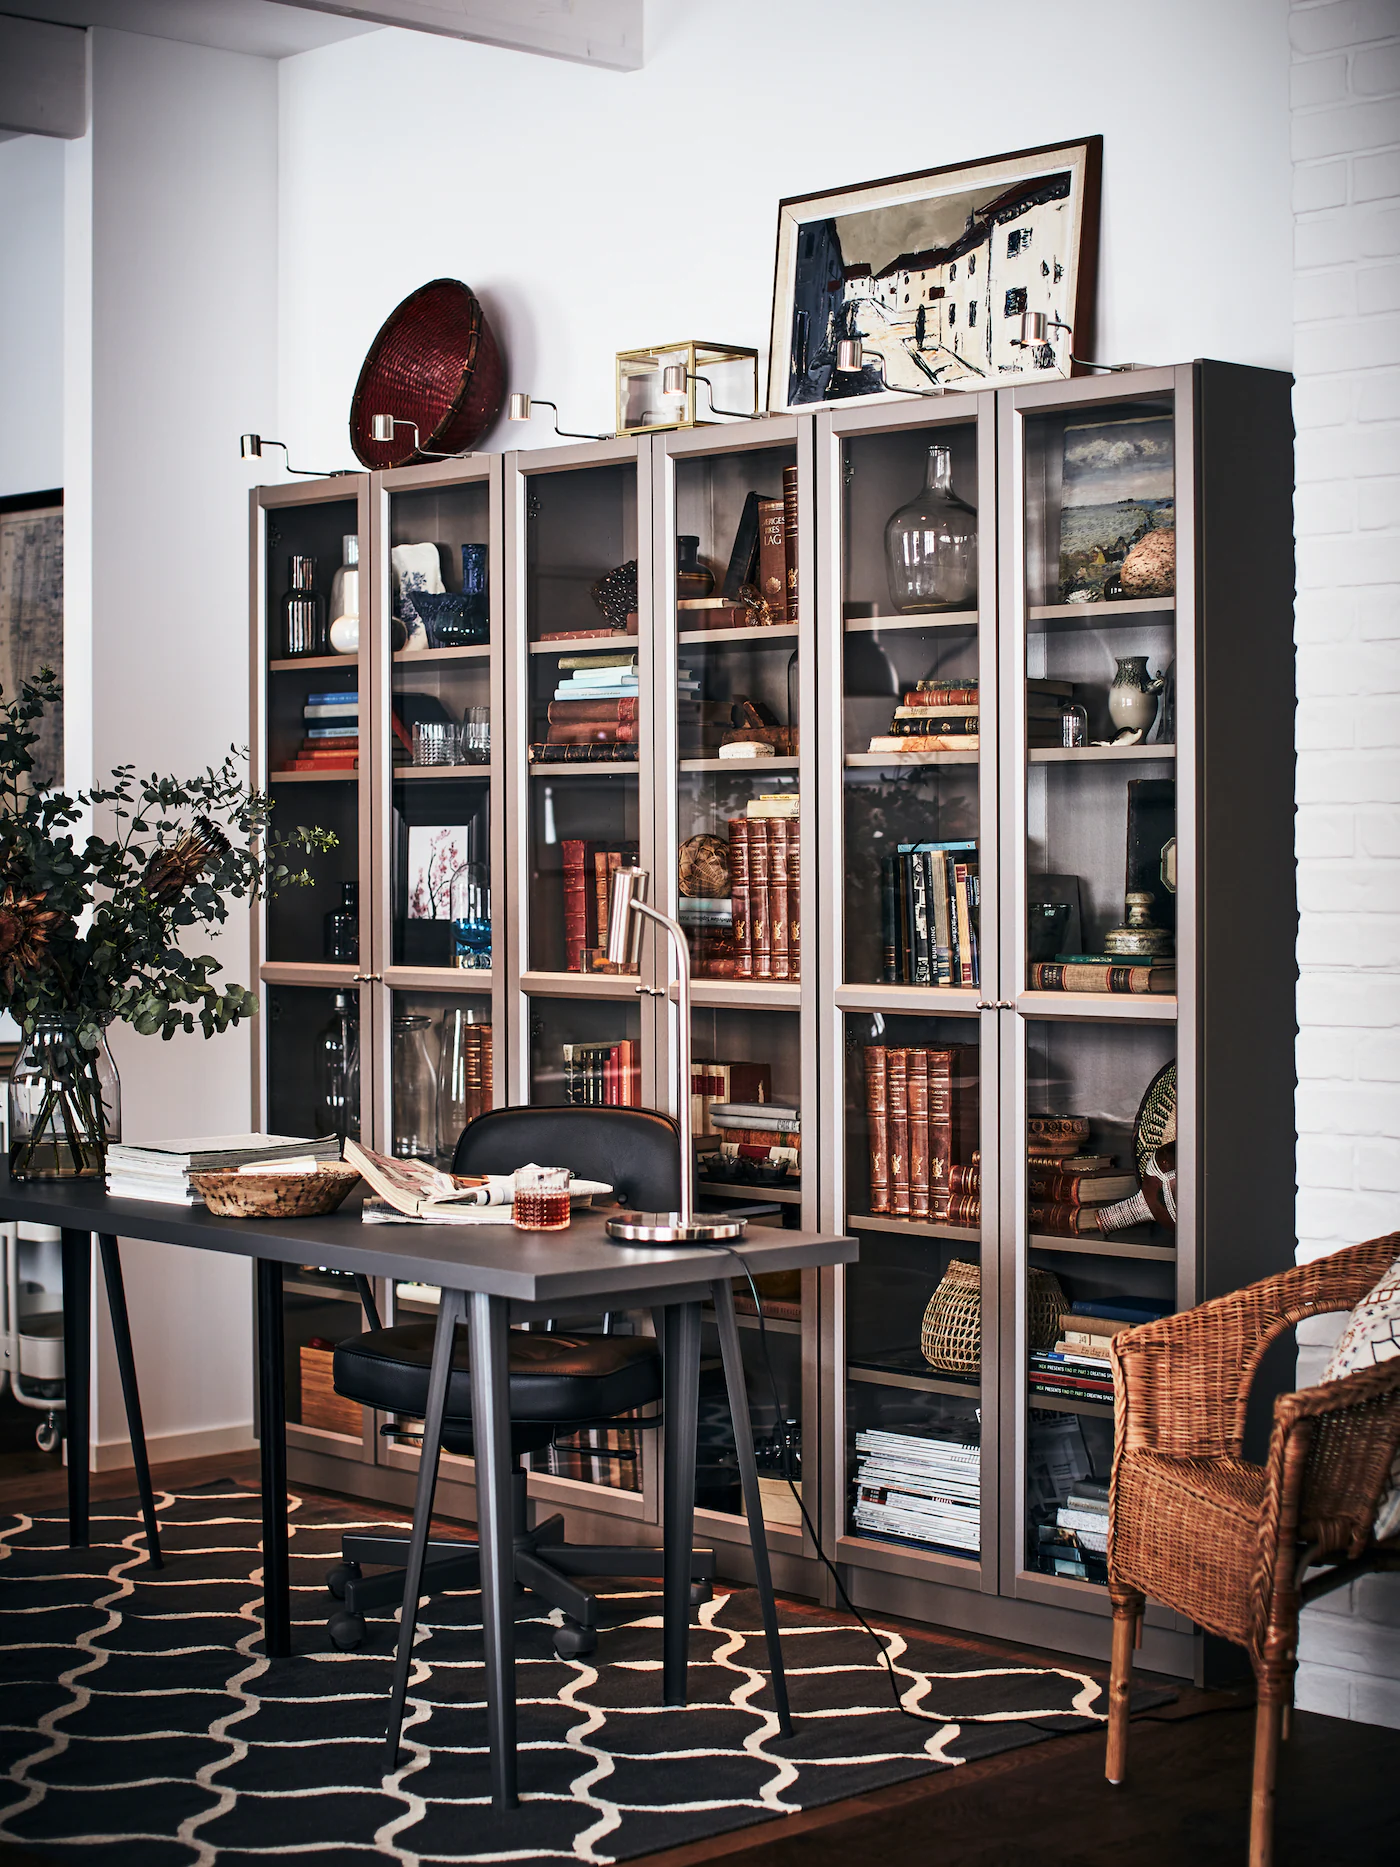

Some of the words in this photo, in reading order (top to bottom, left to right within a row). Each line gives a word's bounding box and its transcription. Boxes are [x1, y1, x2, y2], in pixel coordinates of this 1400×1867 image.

[764, 533, 782, 546] LAG
[930, 926, 938, 960] BUILDING
[1047, 1365, 1064, 1373] PRESENTS
[1045, 1386, 1061, 1394] PRESENTS
